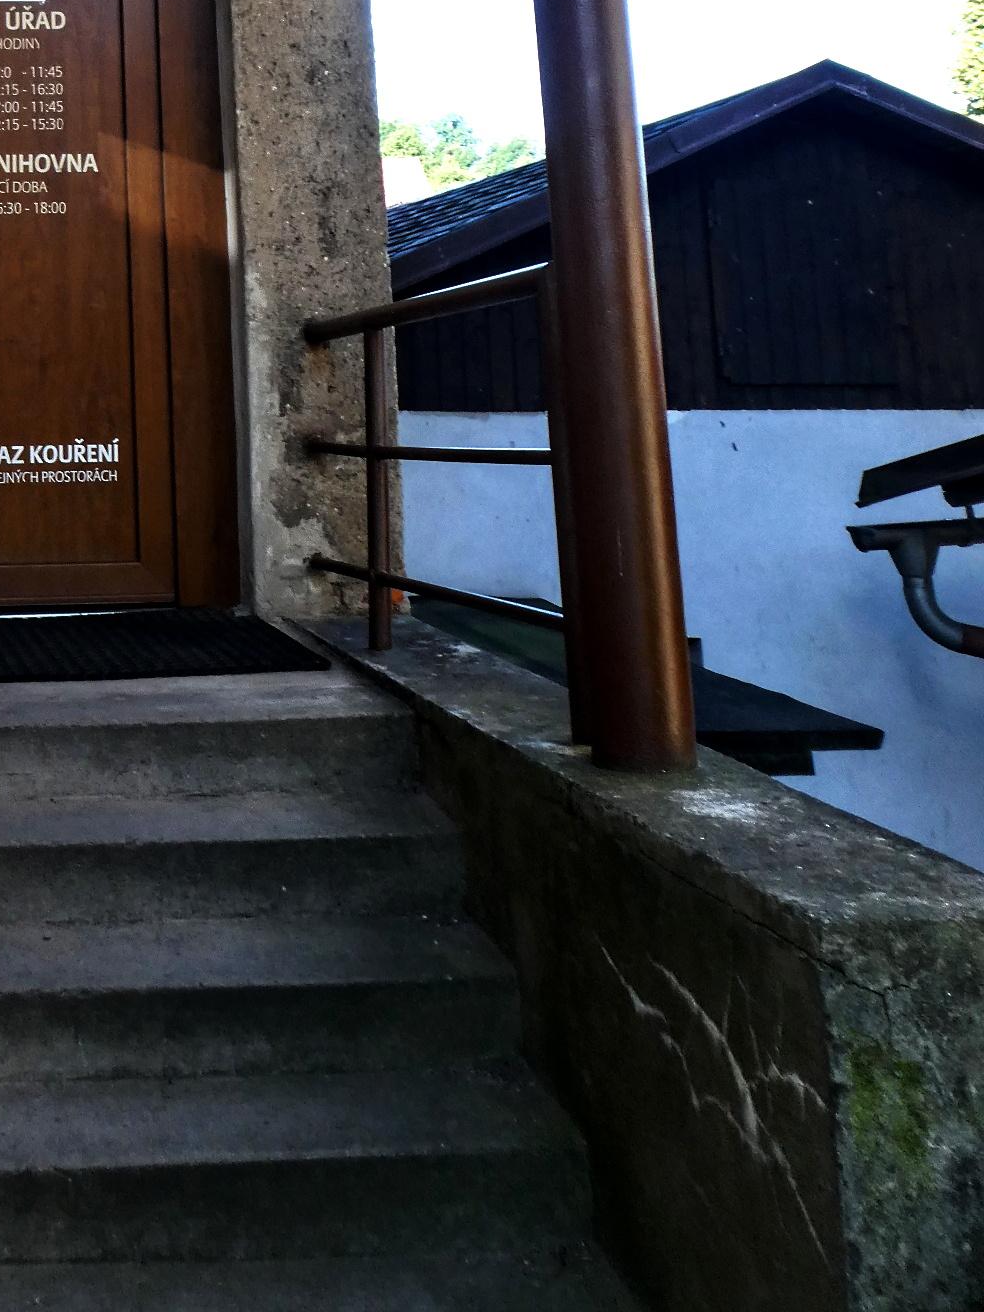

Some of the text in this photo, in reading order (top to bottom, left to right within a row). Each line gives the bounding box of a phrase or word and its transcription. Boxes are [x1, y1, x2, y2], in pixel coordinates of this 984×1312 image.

[6, 6, 66, 30] ÚŘAD
[30, 66, 63, 78] 11:45
[31, 84, 64, 95] 16:30
[31, 101, 64, 113] 11:45
[31, 118, 64, 130] 15:30
[13, 181, 48, 193] DOBA
[33, 202, 66, 214] 18:00
[30, 438, 119, 463] KOUŘENÍ
[41, 468, 117, 483] PROSTORÁCH
